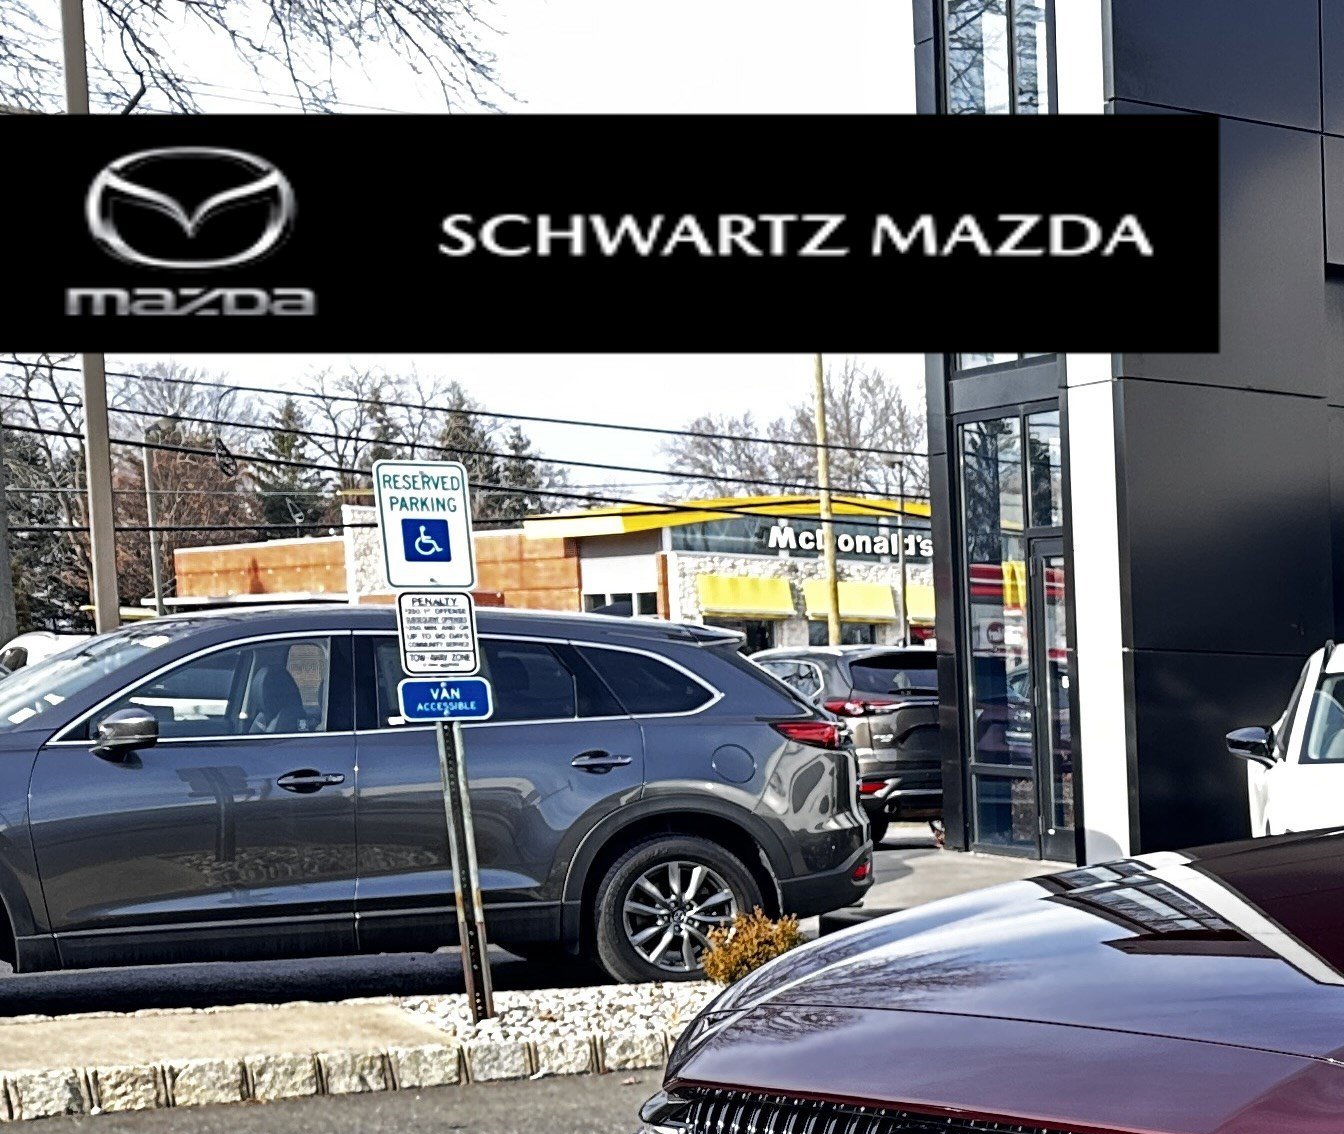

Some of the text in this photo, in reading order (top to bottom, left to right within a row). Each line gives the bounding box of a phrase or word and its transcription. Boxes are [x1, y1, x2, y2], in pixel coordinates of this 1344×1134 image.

[382, 473, 461, 492] RESERVED
[389, 496, 458, 513] PARKING
[411, 597, 458, 607] PENALTY
[430, 687, 461, 700] VAN
[416, 701, 477, 712] ACCESSIBLE
